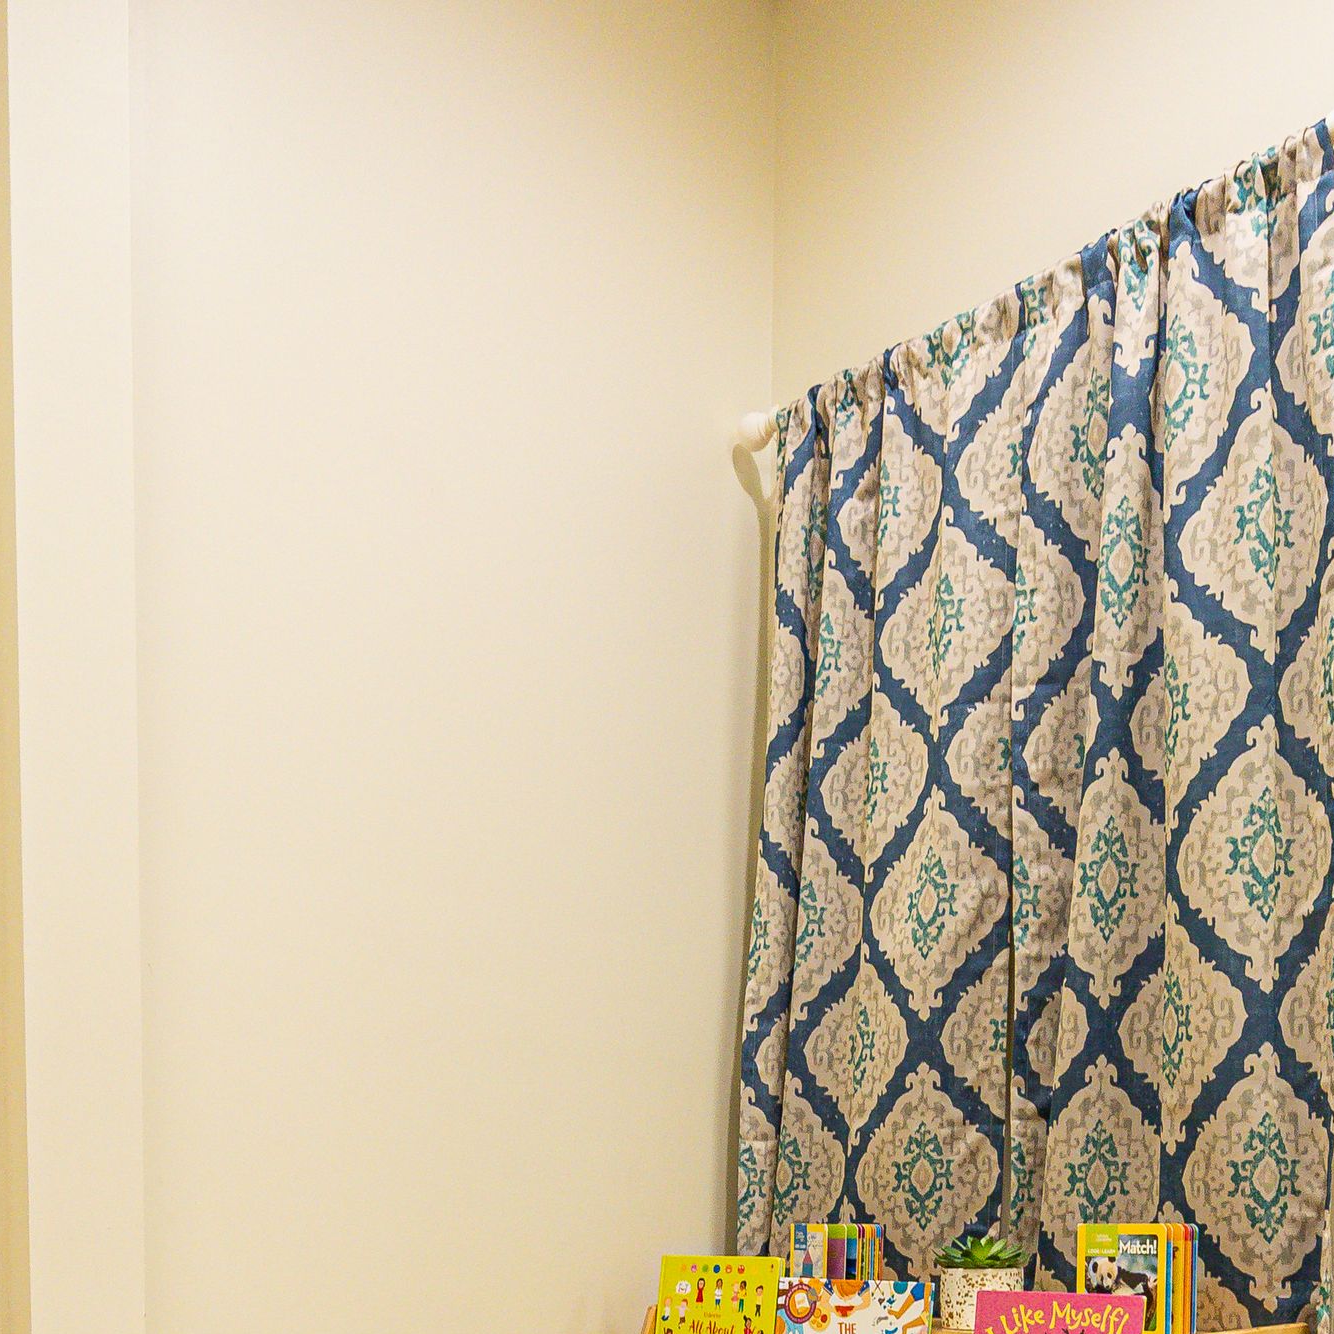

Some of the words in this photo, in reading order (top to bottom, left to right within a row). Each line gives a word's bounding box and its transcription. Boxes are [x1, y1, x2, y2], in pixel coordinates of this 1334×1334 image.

[1119, 1238, 1157, 1255] Match!
[689, 1320, 703, 1334] All
[837, 1321, 857, 1334] THE
